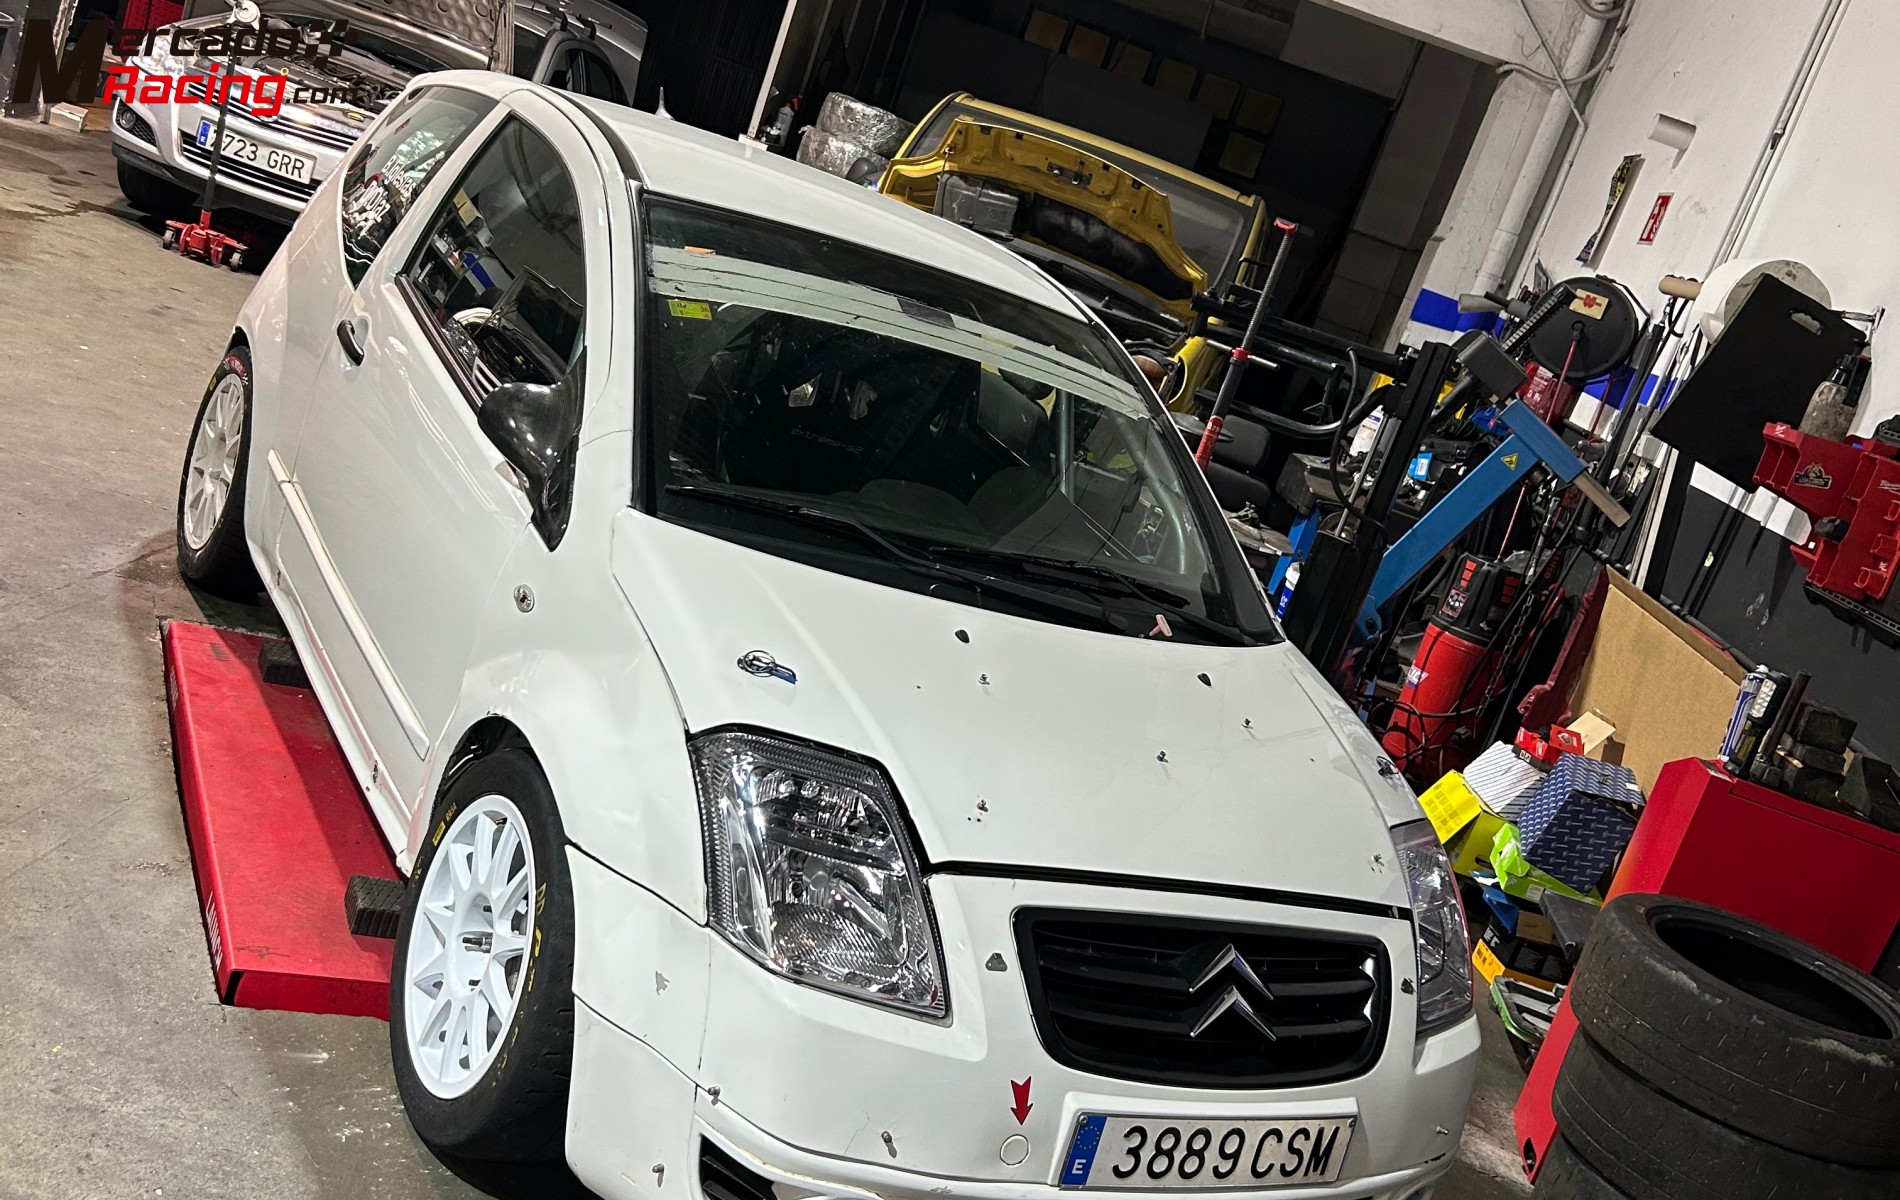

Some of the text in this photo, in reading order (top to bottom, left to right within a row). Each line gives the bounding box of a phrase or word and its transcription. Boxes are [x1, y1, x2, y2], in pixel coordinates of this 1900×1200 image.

[266, 150, 305, 179] GRR
[1111, 1125, 1340, 1180] 3889 CSM
